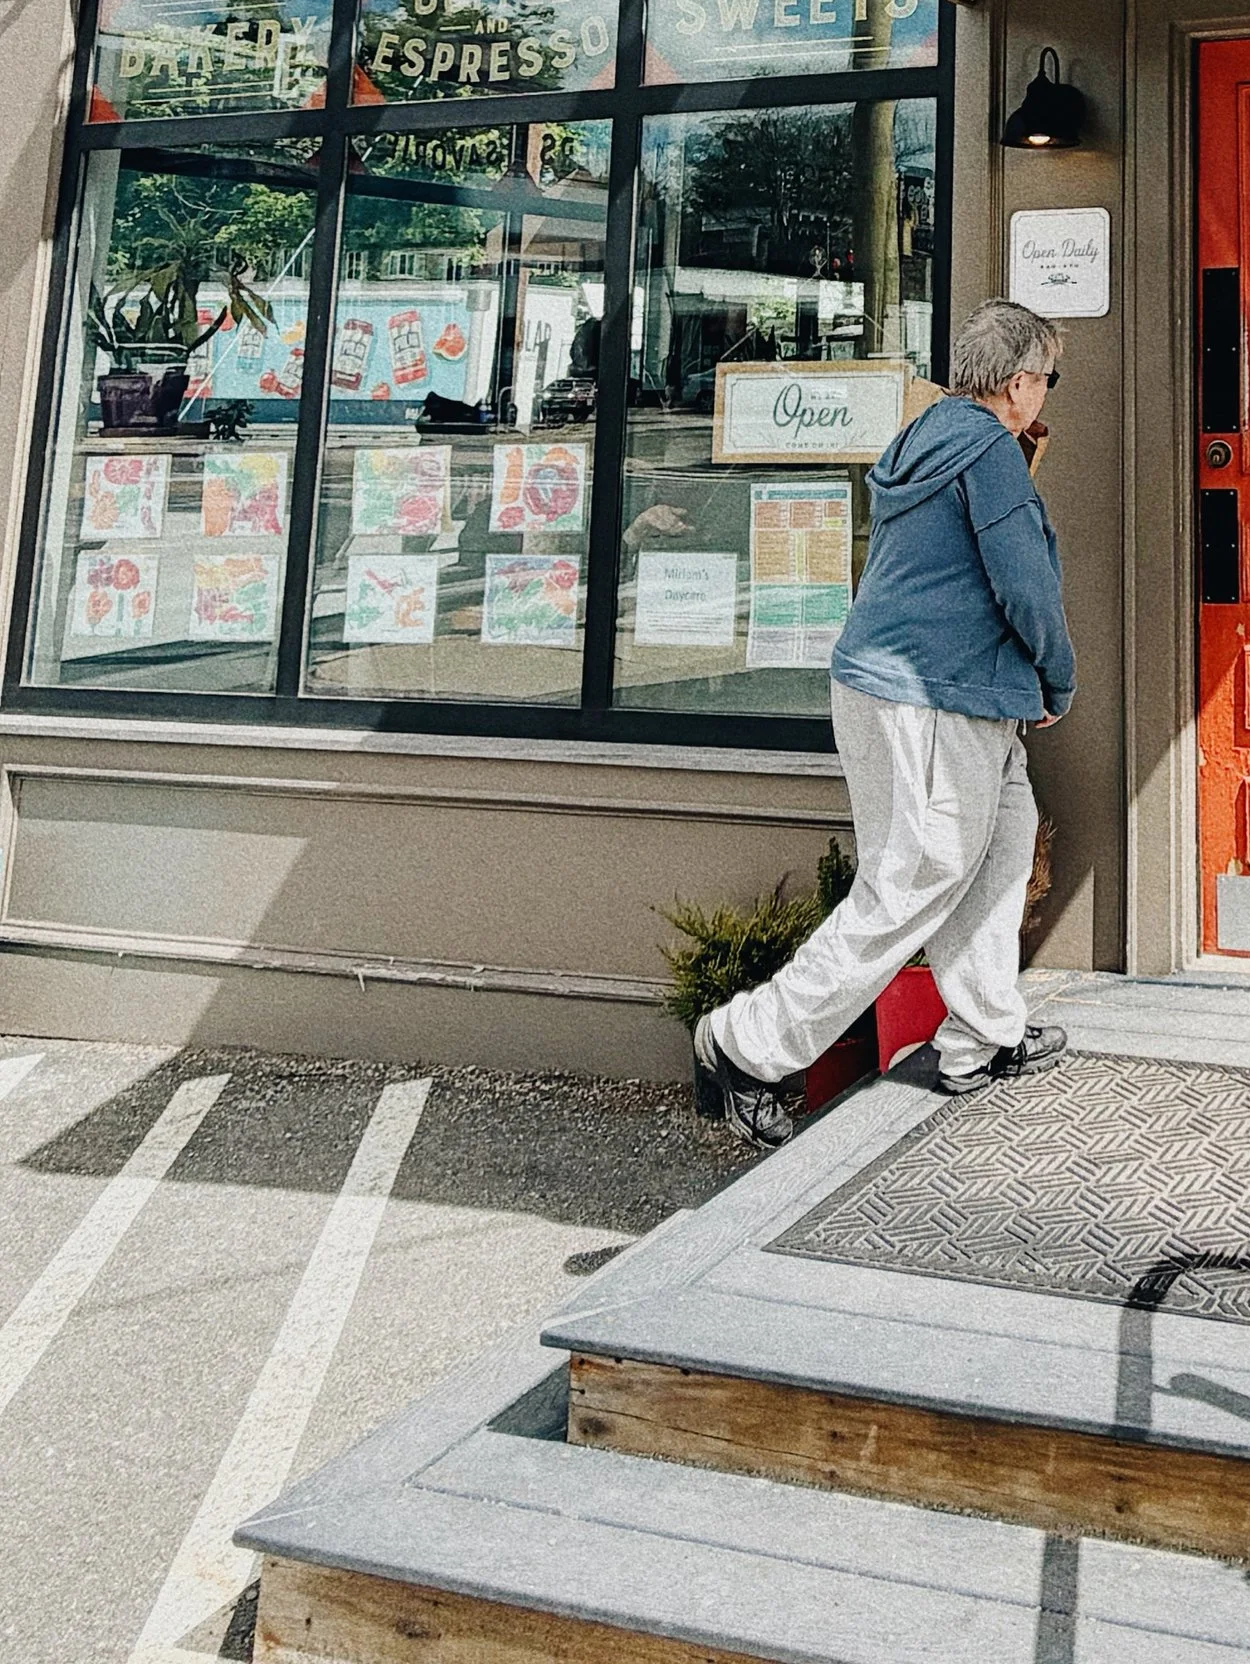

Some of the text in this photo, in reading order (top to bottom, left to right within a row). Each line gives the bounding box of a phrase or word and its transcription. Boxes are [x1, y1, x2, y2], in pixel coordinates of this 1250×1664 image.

[119, 15, 317, 78] BAKERY
[371, 14, 610, 83] ESPRESSO
[474, 18, 509, 35] AND
[1022, 238, 1099, 264] Open Daily
[773, 383, 853, 439] Open
